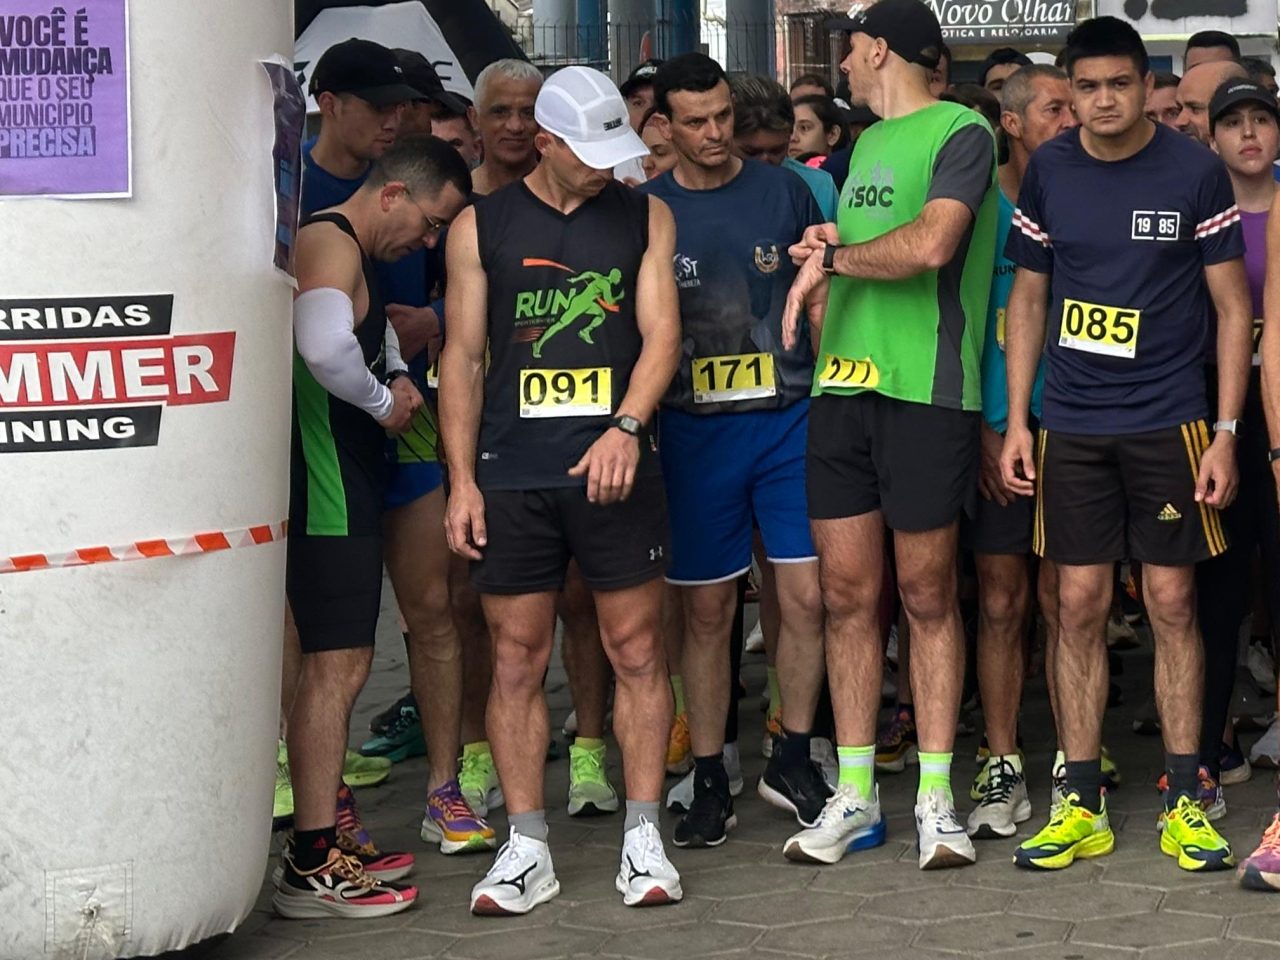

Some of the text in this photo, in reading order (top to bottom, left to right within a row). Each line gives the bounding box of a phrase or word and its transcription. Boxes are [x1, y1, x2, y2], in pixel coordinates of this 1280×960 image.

[0, 6, 89, 47] VOCÊ É
[980, 29, 985, 37] E
[0, 47, 113, 84] MUDANÇA
[38, 77, 50, 100] O
[56, 76, 93, 100] SEU
[0, 100, 93, 127] MUNICÍPIO
[0, 128, 94, 158] PRECISA
[1136, 217, 1175, 234] 19 85
[515, 288, 577, 318] RUN
[1066, 303, 1136, 344] 085
[522, 370, 600, 406] 091
[700, 356, 762, 391] 171
[0, 416, 136, 443] NING
